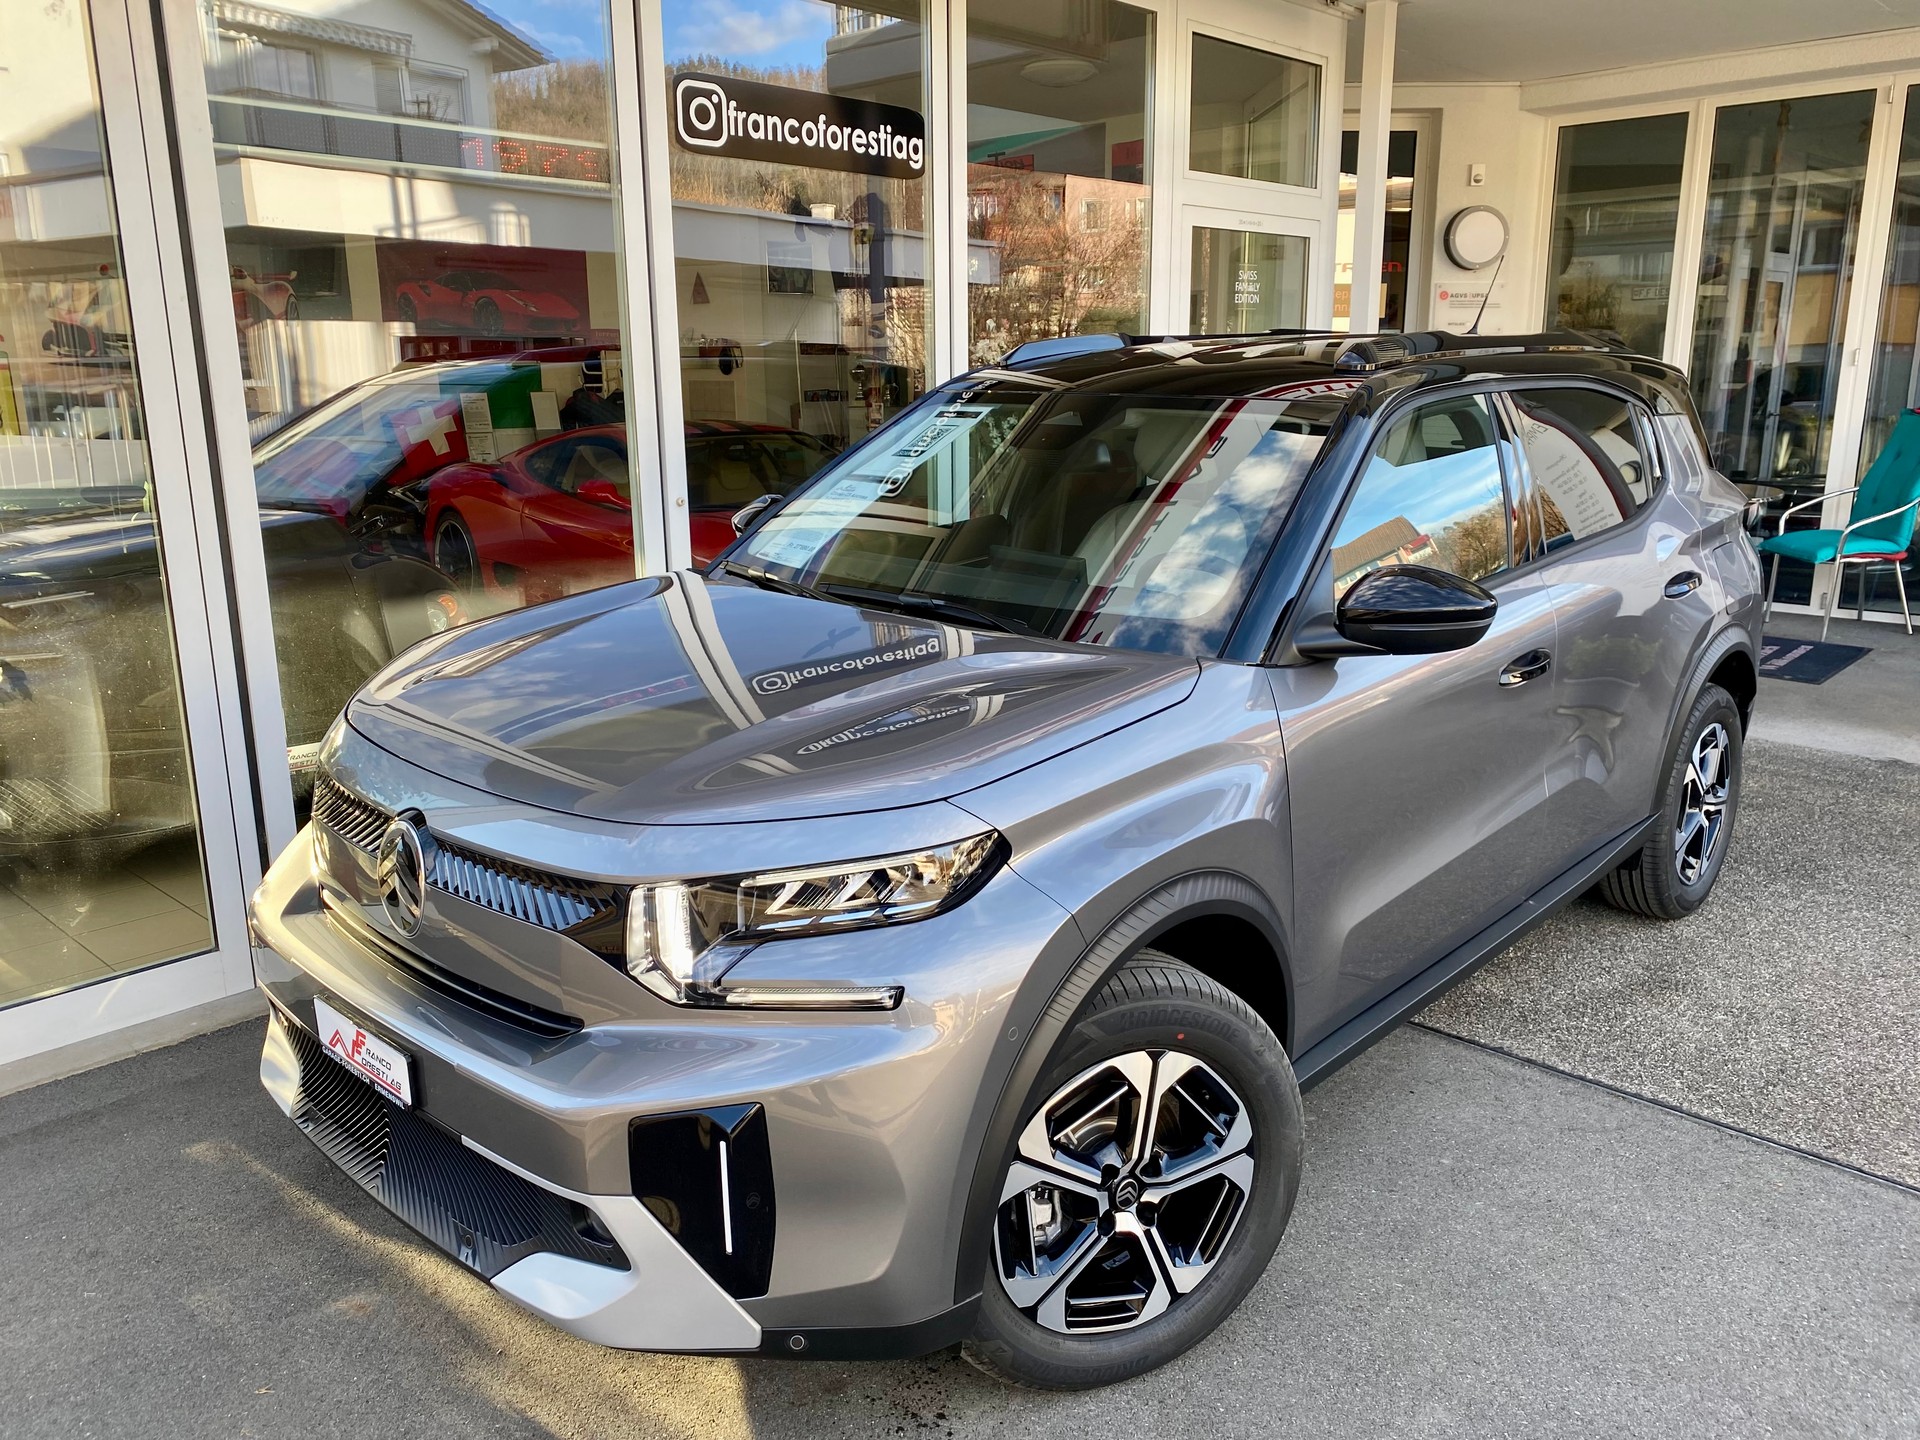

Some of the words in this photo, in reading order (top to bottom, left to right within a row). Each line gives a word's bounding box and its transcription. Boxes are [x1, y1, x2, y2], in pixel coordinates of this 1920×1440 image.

[727, 99, 924, 170] francoforestiag
[1238, 270, 1258, 281] SWISS
[1234, 293, 1260, 304] EDITION
